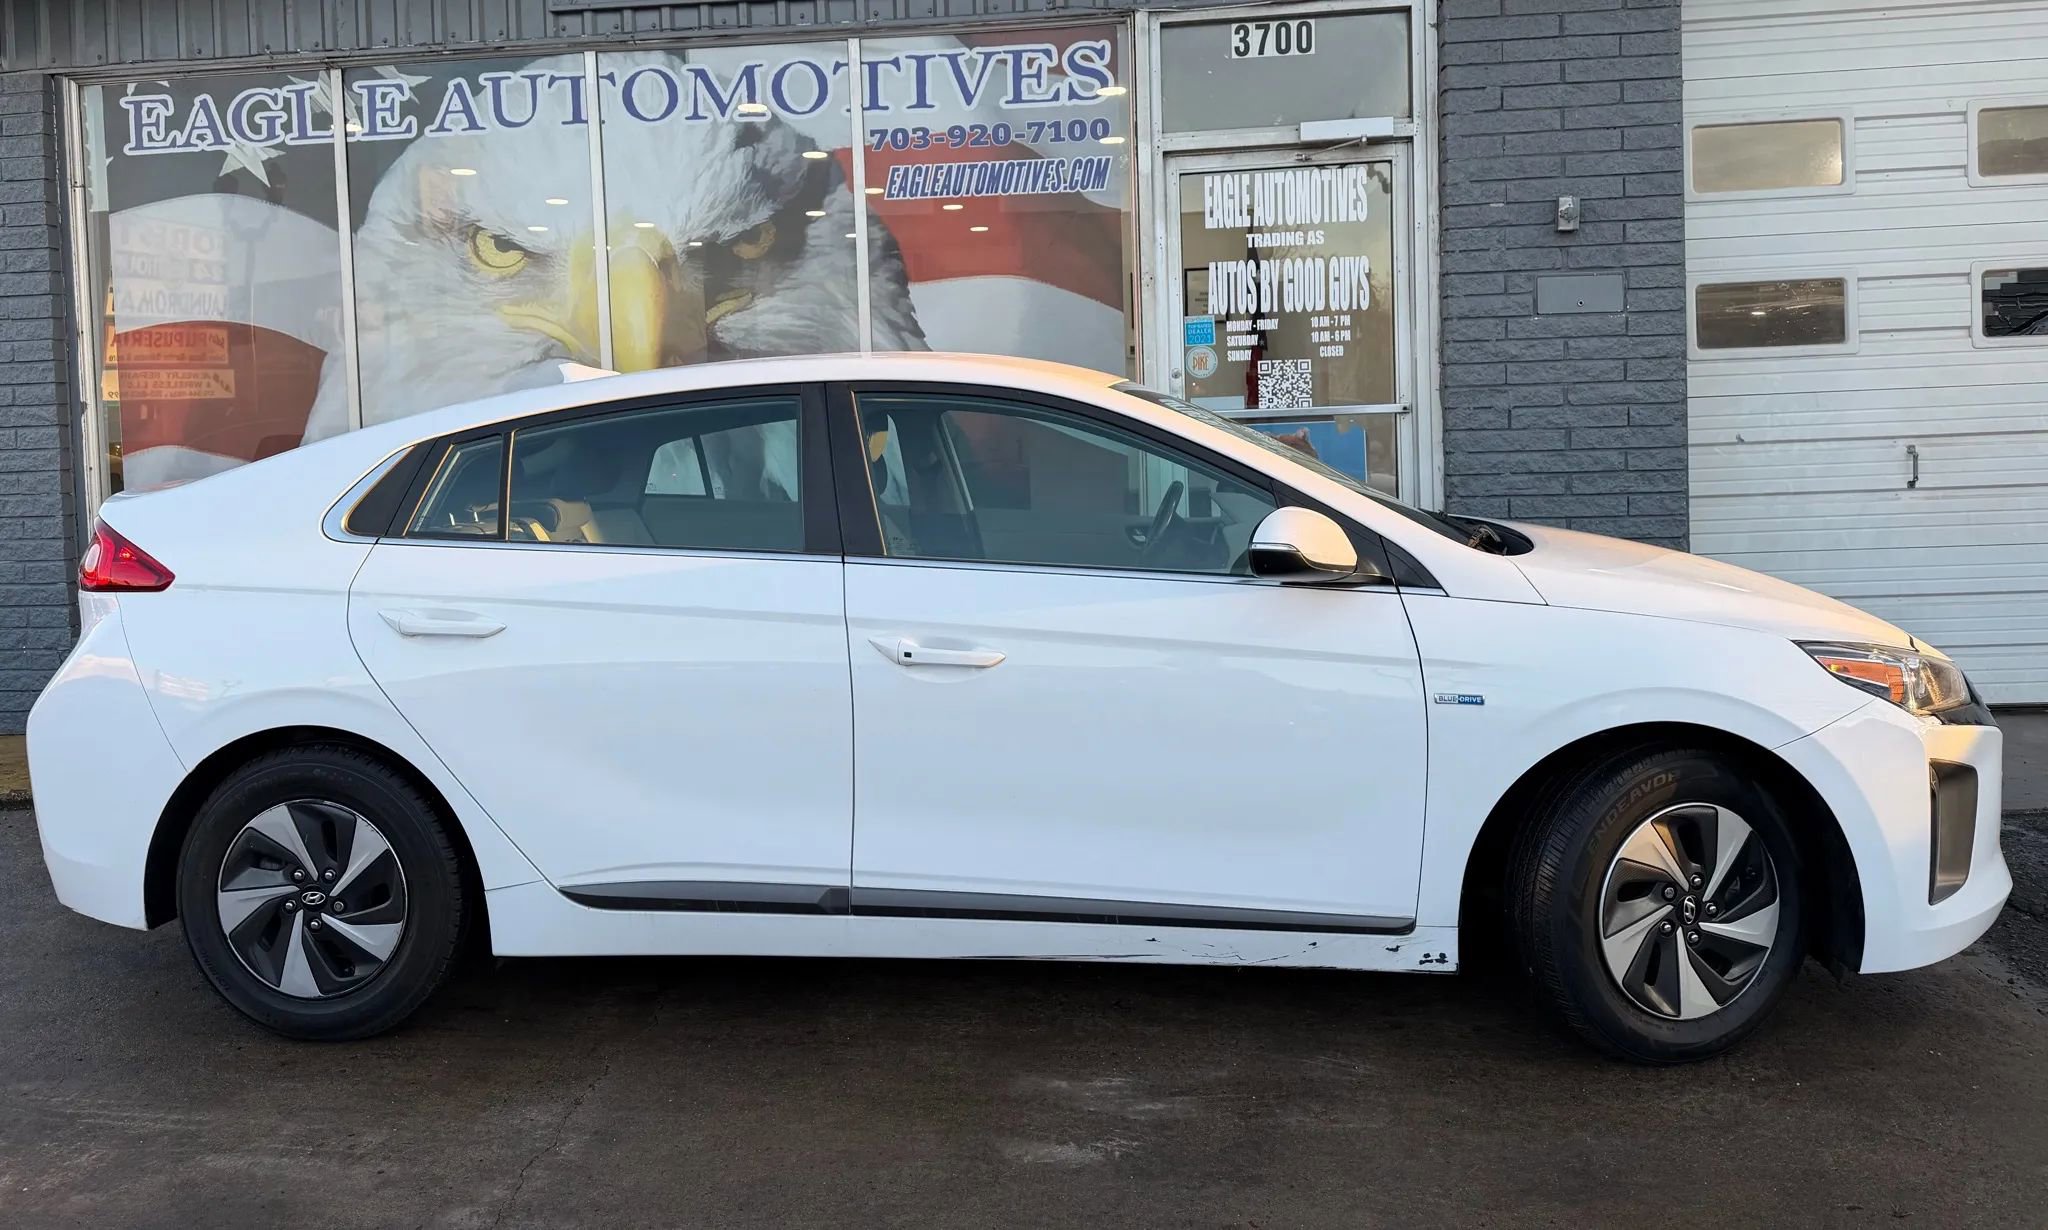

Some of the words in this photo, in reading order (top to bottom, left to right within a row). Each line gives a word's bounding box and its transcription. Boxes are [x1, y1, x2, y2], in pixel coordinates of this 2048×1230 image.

[1234, 21, 1313, 57] 3700
[120, 78, 416, 155] EAGLE
[426, 40, 1118, 138] AUTOMOTIVES
[870, 118, 1110, 151] 703-920-7100
[884, 156, 1113, 200] EAGLEAUTOMOTIVES.COM
[1204, 173, 1251, 229] EAGLE
[1254, 166, 1368, 227] AUTOMOTIVES
[1246, 231, 1304, 248] TRADING
[1307, 230, 1325, 245] AS
[1208, 260, 1257, 315] AUTOS
[1260, 259, 1280, 313] BY
[1283, 257, 1326, 313] GOOD
[1329, 256, 1370, 311] GUYS
[1227, 320, 1252, 332] MONDAY
[1257, 318, 1279, 330] FRIDAY
[1311, 316, 1318, 328] 10
[1320, 316, 1330, 327] AM
[1334, 315, 1339, 327] 7
[1340, 315, 1351, 326] PM
[1188, 335, 1212, 343] 2021
[1227, 335, 1258, 347] SATURDAY
[1311, 332, 1318, 343] 10
[1320, 331, 1330, 342] AM
[1340, 330, 1351, 341] PM
[1227, 350, 1252, 362] SUNDAY
[1320, 346, 1344, 357] CLOSED
